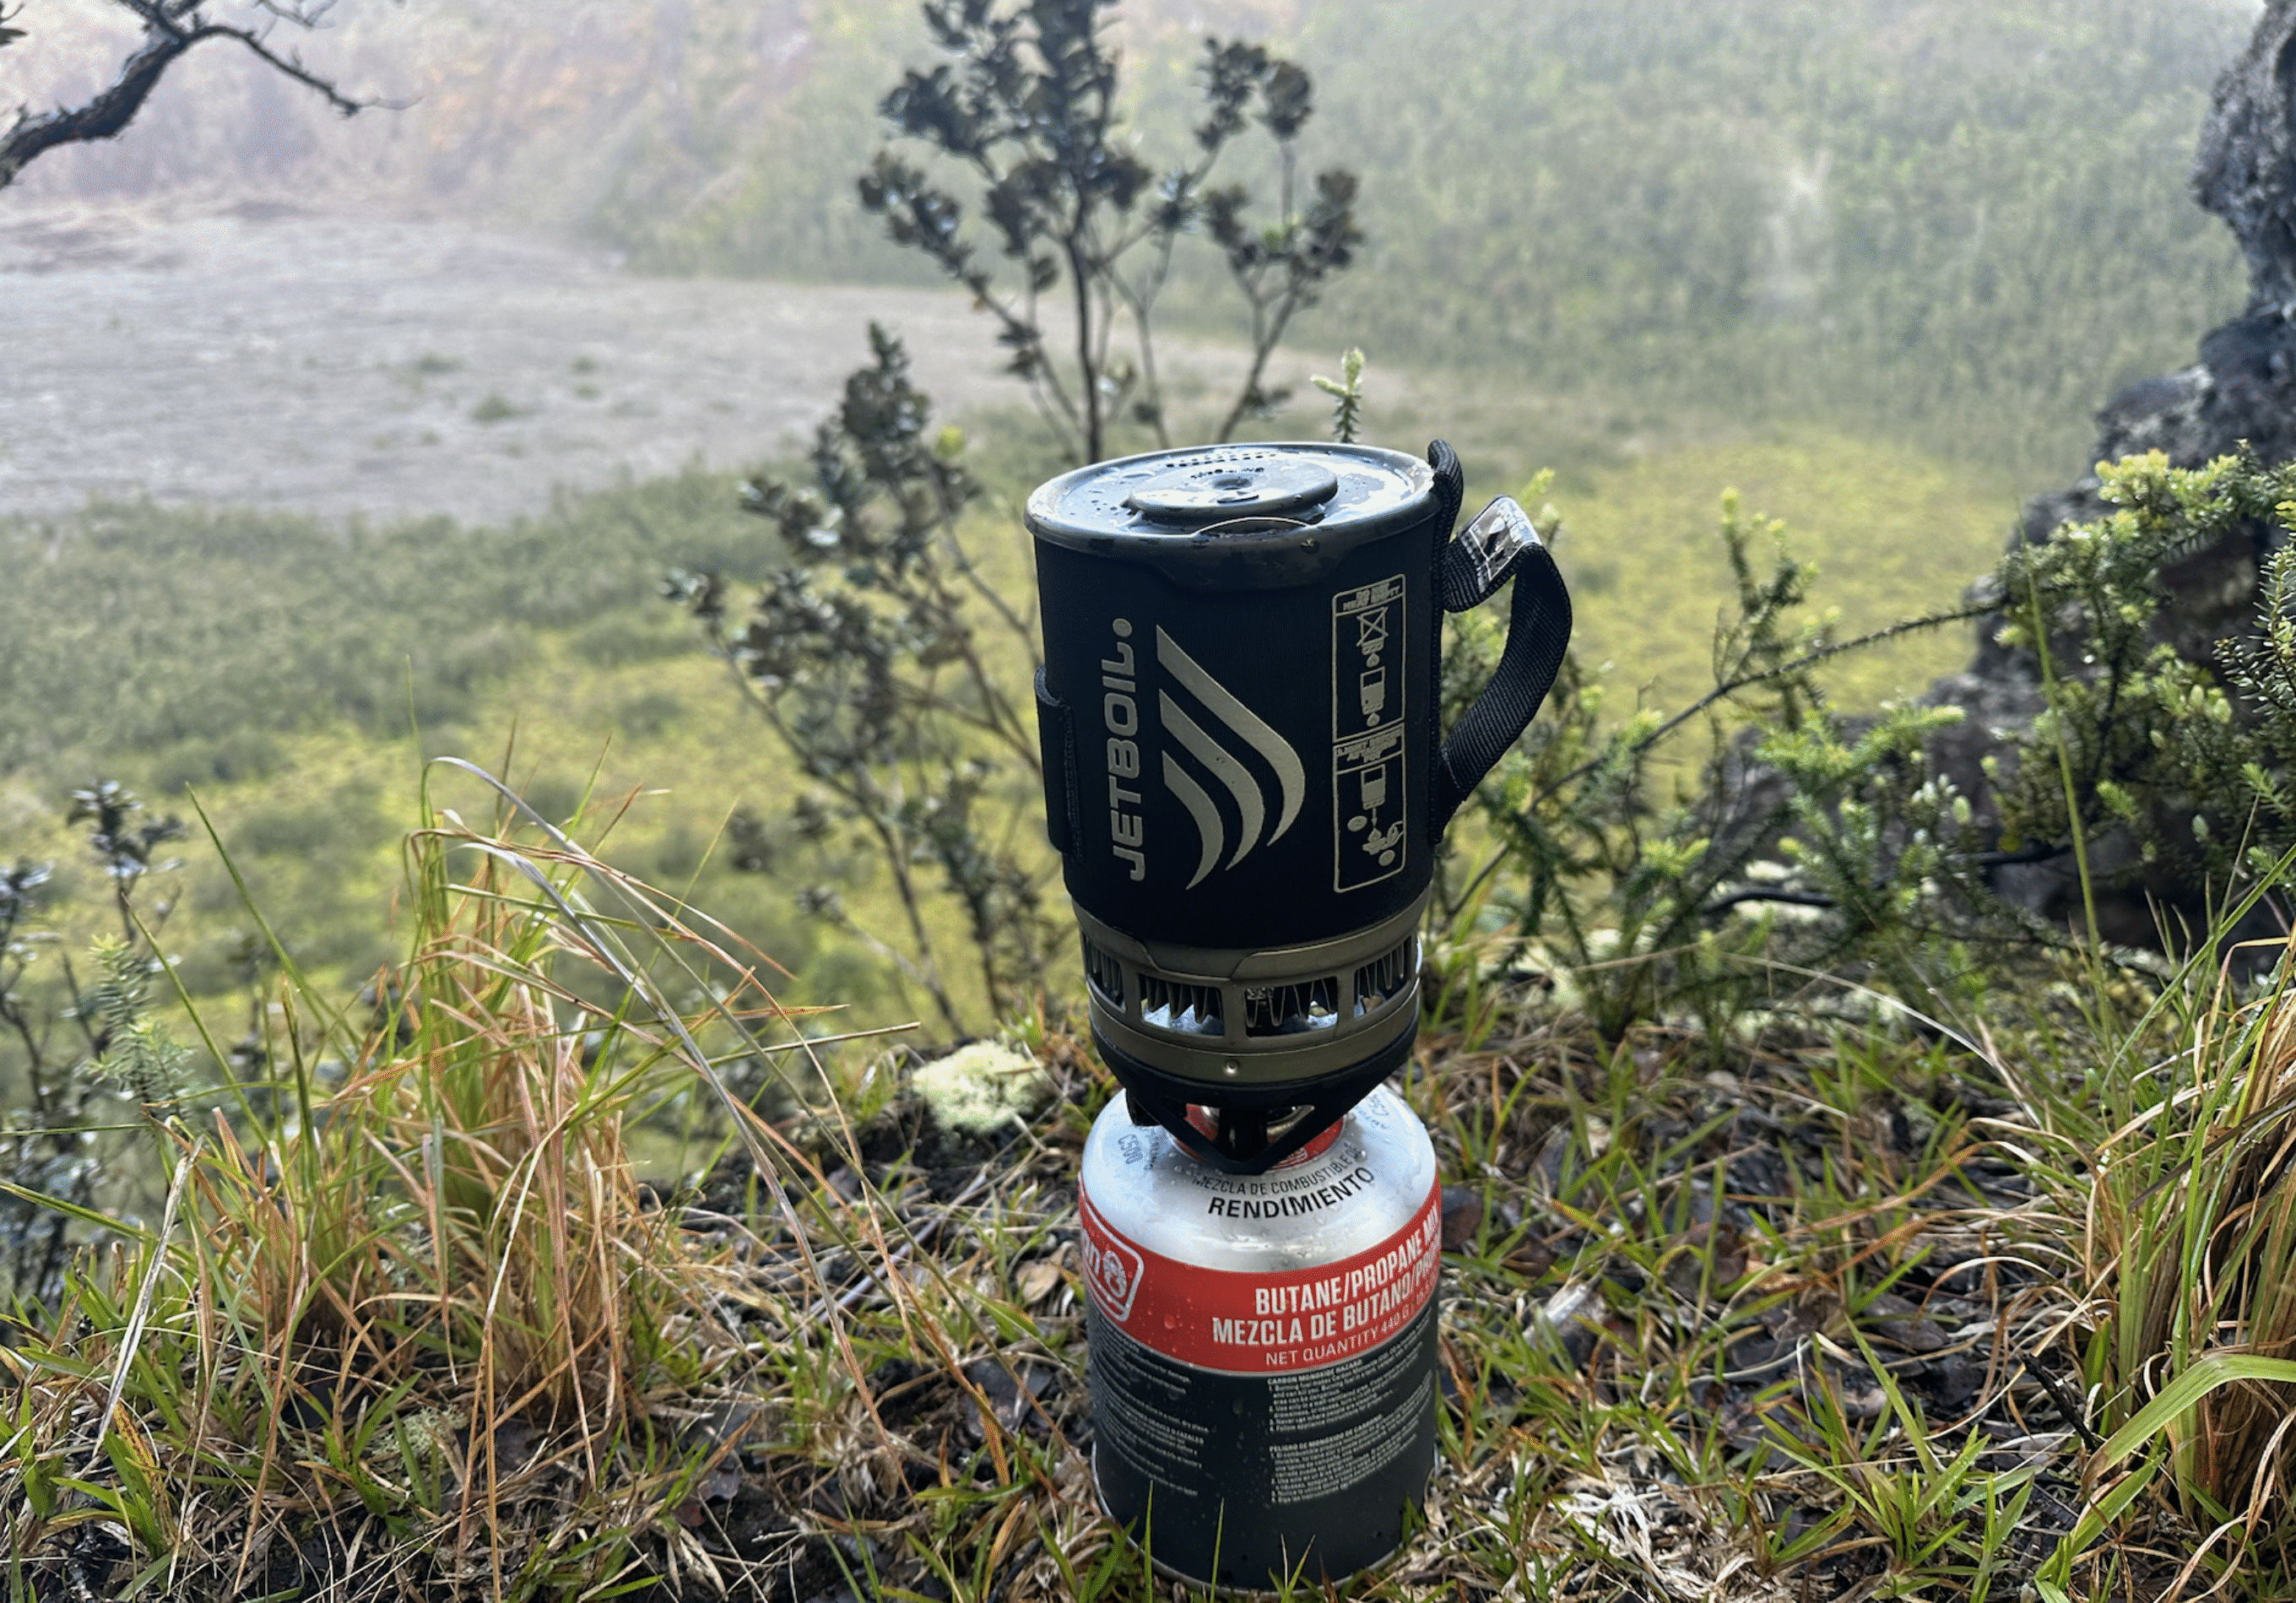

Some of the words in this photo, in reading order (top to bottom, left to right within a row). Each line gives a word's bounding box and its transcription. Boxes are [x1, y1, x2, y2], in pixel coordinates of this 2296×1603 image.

[1101, 639, 1146, 882] JETBOIL
[1192, 1174, 1246, 1195] MEZCLA
[1250, 1183, 1267, 1195] DE
[1271, 1154, 1354, 1194] COMBUSTIBLE
[1208, 1167, 1375, 1218] RENDIMIENTO
[1254, 1228, 1423, 1315] BUTANE/PROPANE
[1212, 1316, 1304, 1346] MEZCLA
[1310, 1310, 1337, 1340] DE
[1265, 1350, 1298, 1366] NET
[1302, 1325, 1379, 1362] QUANTITY
